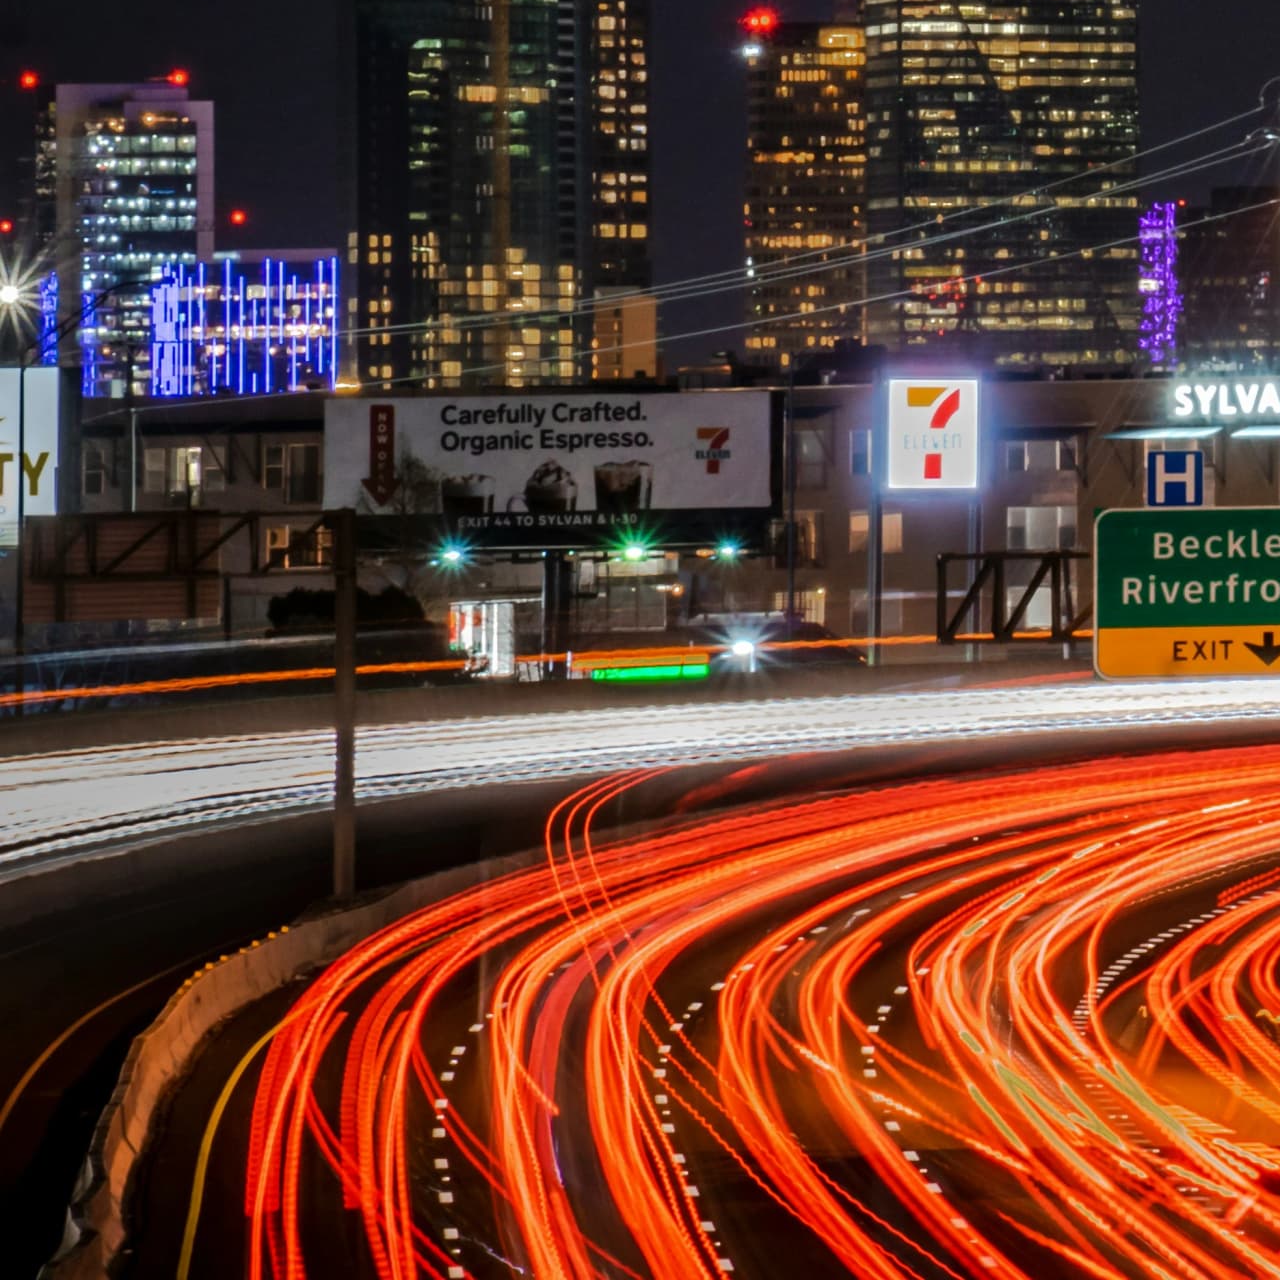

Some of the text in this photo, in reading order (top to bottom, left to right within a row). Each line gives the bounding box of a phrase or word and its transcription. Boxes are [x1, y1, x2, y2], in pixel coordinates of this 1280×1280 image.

[376, 412, 389, 444] NOW
[440, 401, 647, 427] Carefully Crafted.
[440, 429, 654, 456] Organic Espresso.
[906, 387, 961, 480] 7
[696, 426, 730, 475] 7
[376, 451, 388, 495] ON
[1155, 453, 1196, 504] H
[457, 516, 490, 529] EXIT
[494, 517, 512, 528] 44
[516, 516, 535, 527] TO
[538, 514, 593, 526] SYLVAN
[1172, 639, 1234, 662] EXIT
